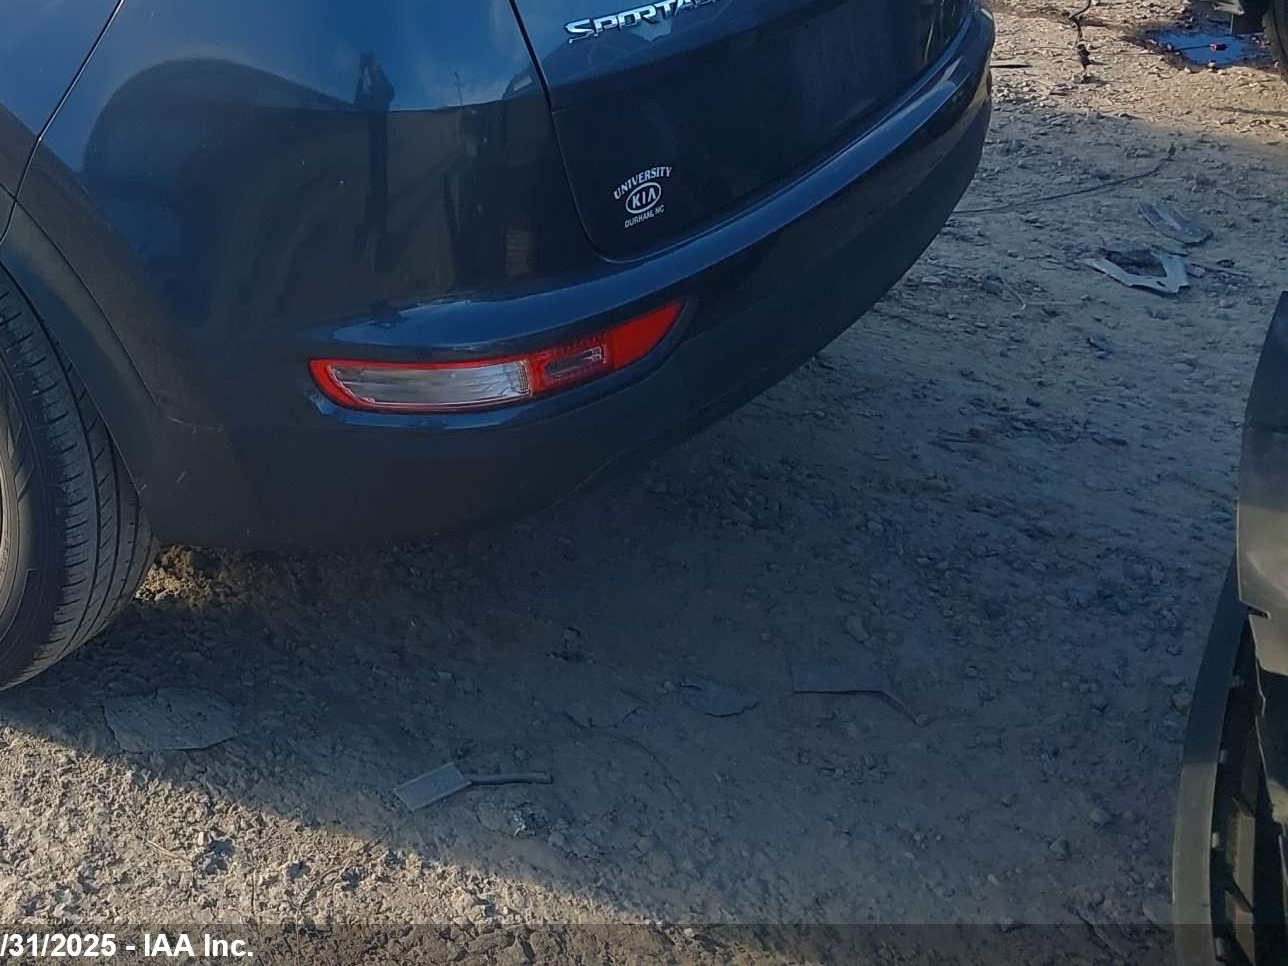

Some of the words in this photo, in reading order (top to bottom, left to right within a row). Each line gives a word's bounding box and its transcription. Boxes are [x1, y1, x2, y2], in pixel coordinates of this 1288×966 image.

[613, 166, 673, 200] UNIVERSITY
[632, 187, 657, 209] KIA
[654, 204, 665, 215] NC
